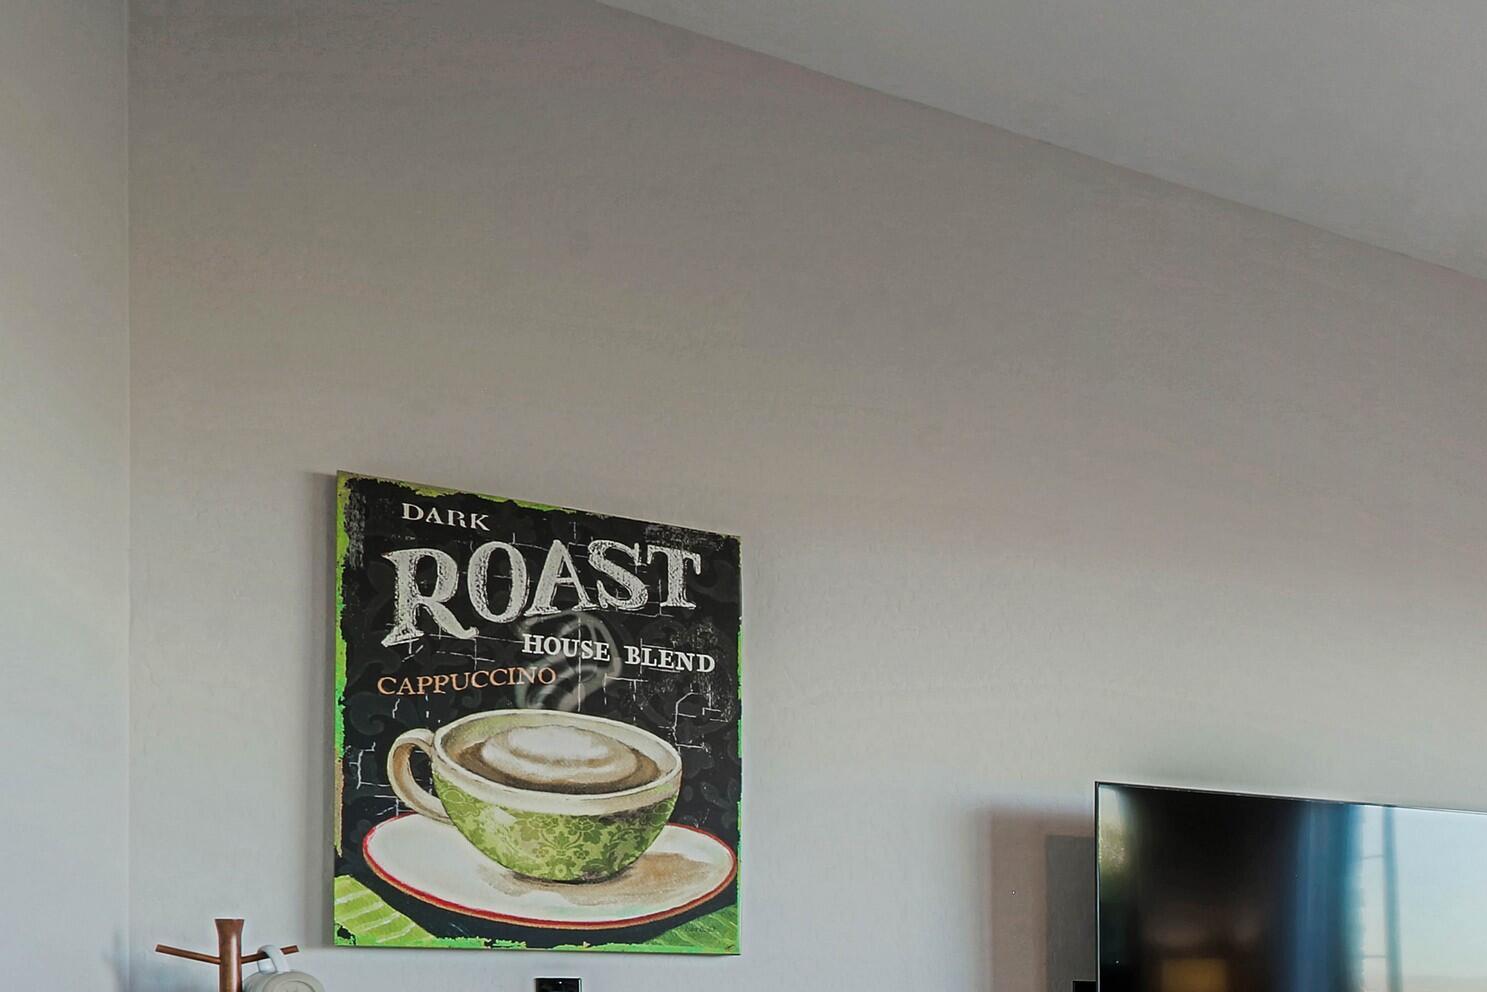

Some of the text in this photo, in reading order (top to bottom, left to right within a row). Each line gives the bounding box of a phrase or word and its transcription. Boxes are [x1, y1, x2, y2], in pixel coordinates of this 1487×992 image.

[401, 502, 491, 532] DARK
[380, 538, 702, 648] ROAST
[521, 633, 716, 674] HOUSE BLEND
[376, 665, 557, 697] CAPPUCCINO
